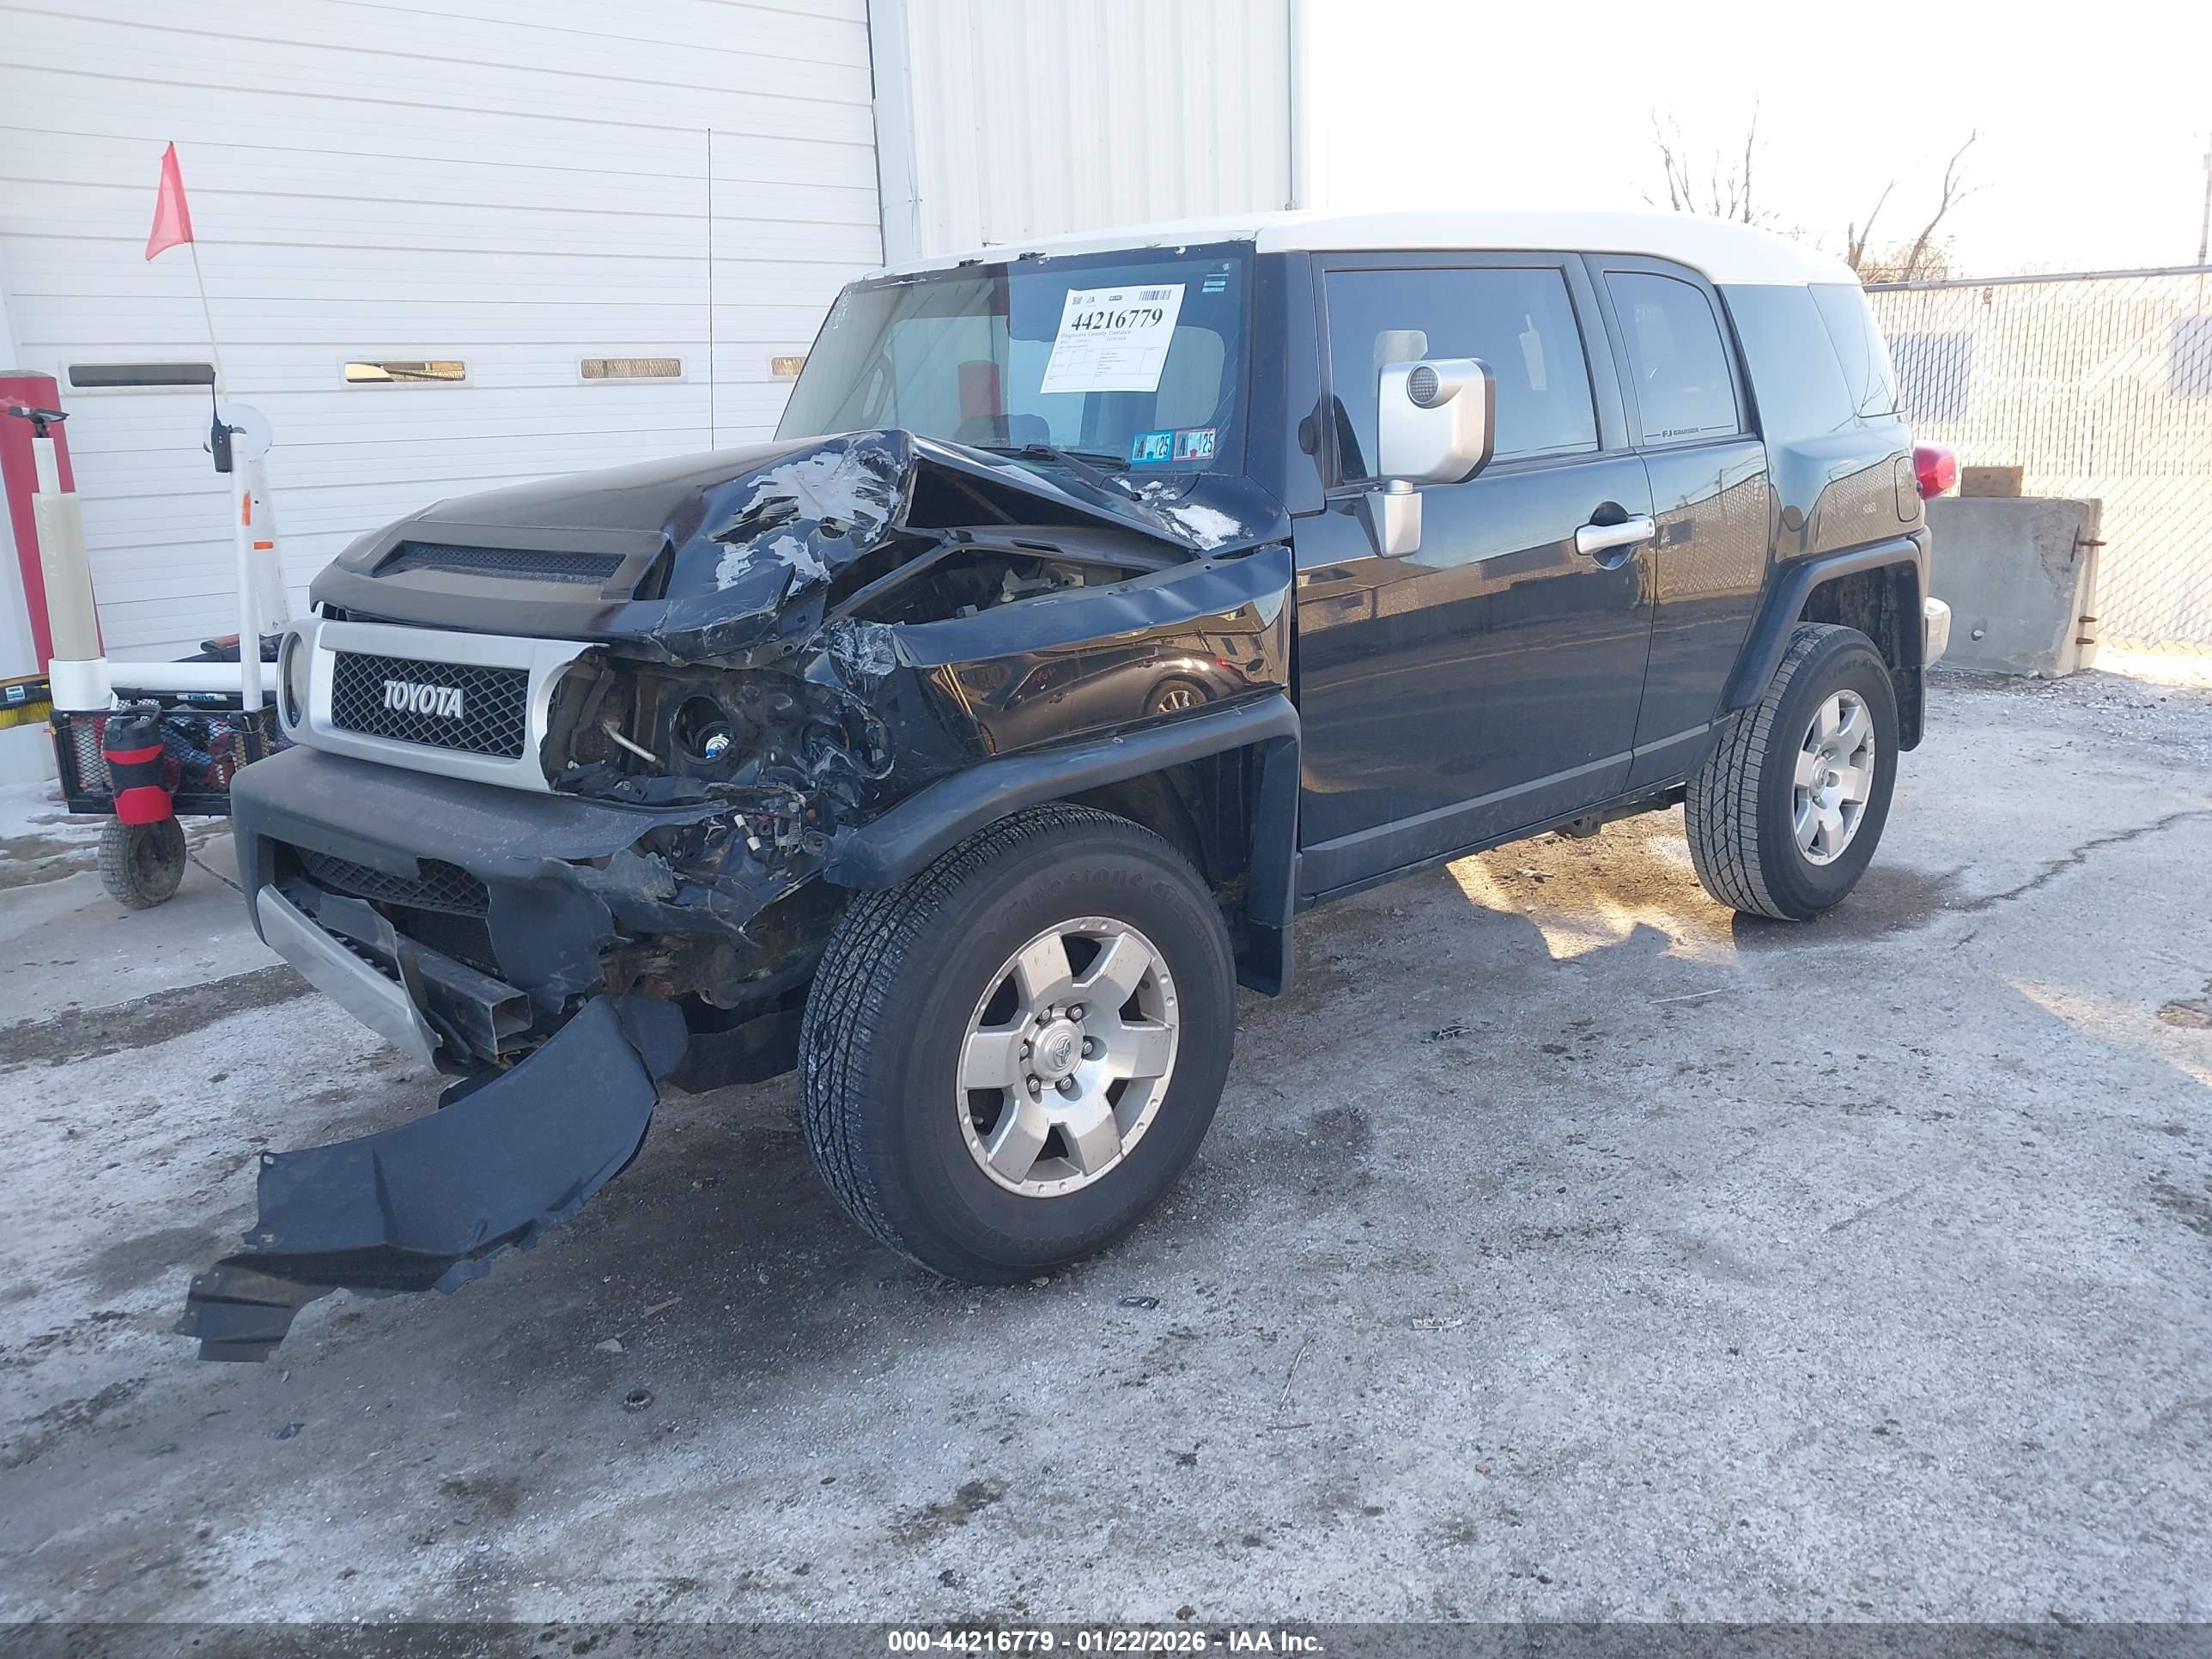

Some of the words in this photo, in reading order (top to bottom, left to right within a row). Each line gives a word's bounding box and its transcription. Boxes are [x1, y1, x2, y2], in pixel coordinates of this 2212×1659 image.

[1072, 308, 1163, 331] 44216779
[1179, 437, 1186, 456] 4
[1203, 433, 1213, 453] 25
[1662, 429, 1672, 438] FJ
[1137, 440, 1145, 459] 4
[1158, 436, 1170, 456] 25
[384, 679, 464, 719] TOYOTA
